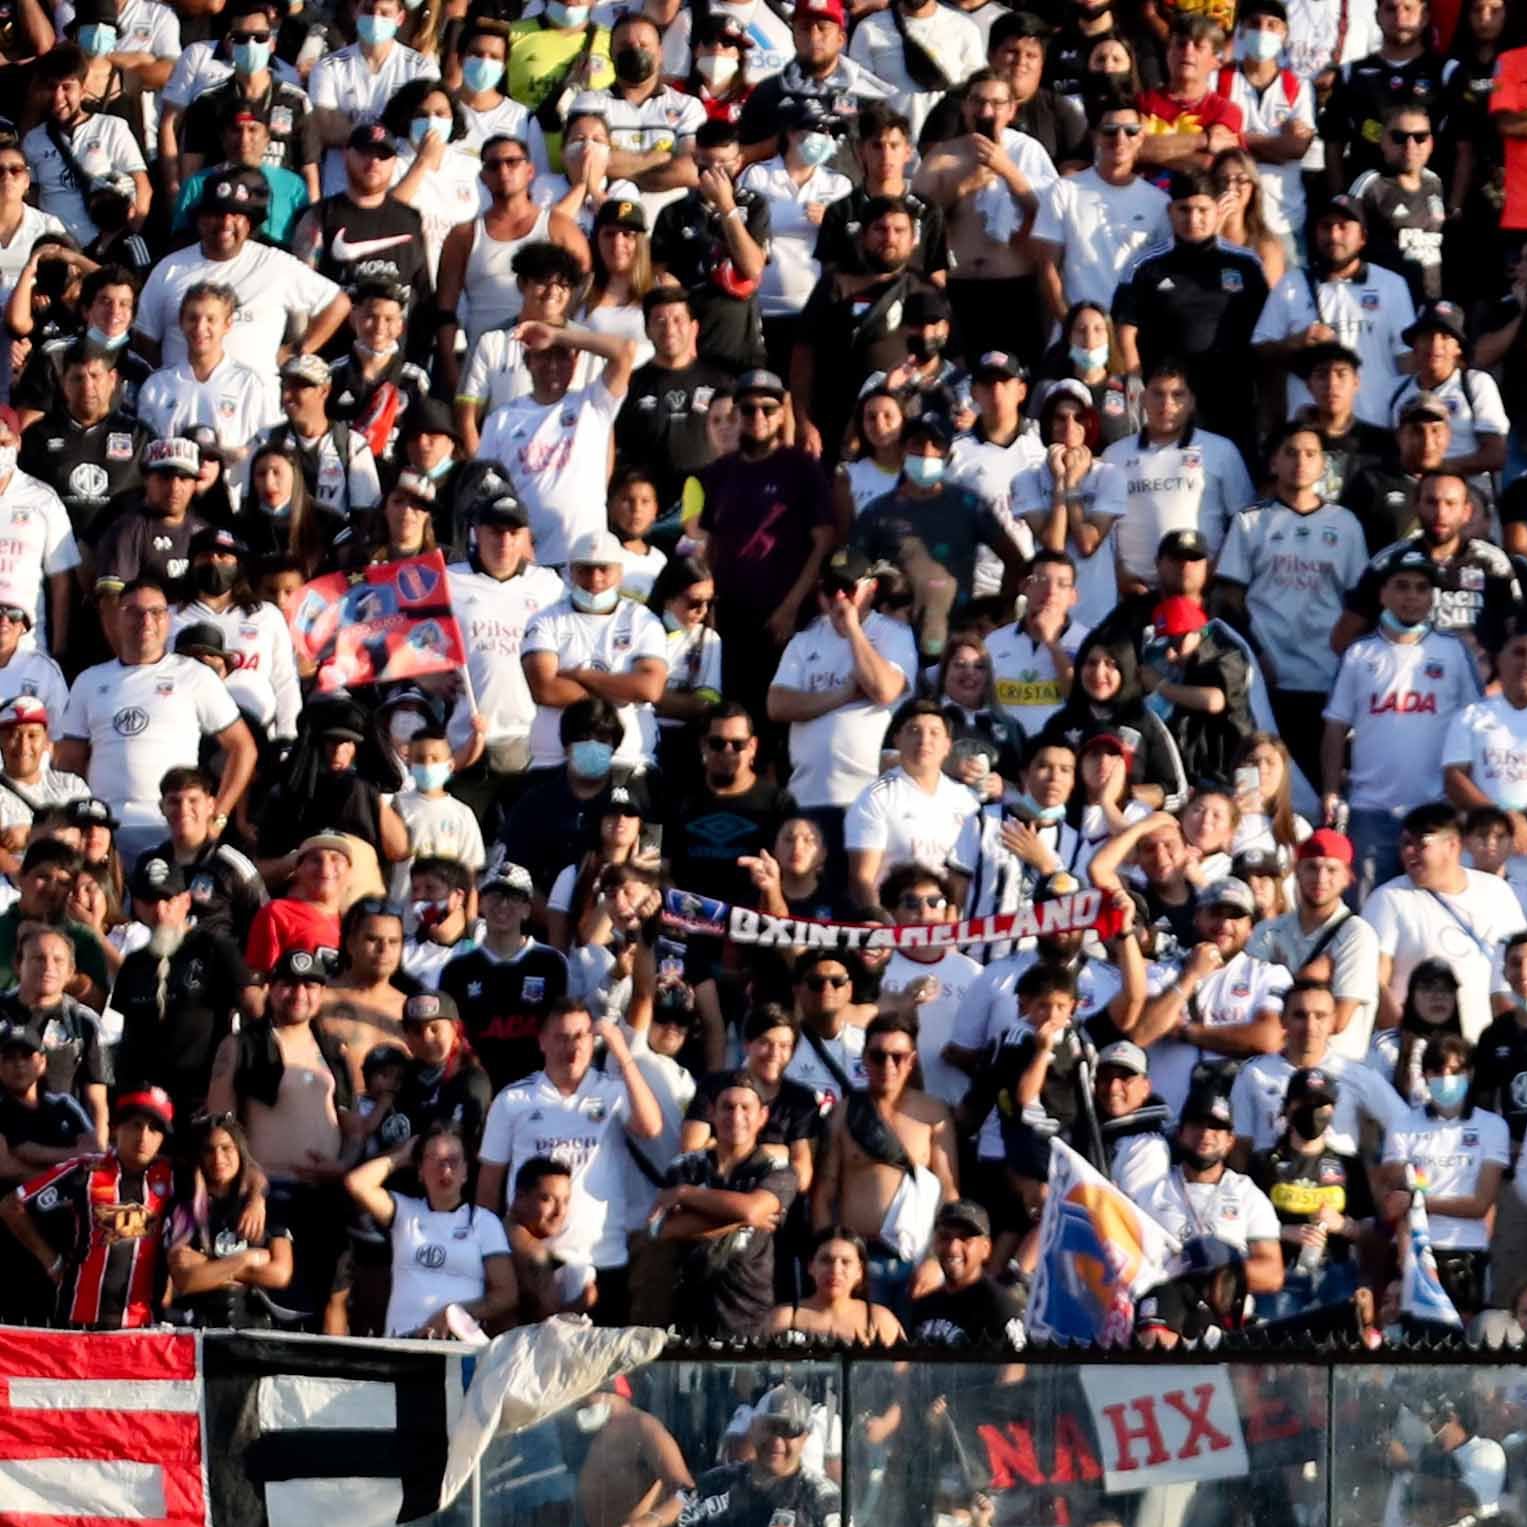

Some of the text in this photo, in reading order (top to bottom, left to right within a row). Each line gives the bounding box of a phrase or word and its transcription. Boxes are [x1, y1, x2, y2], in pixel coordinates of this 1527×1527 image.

[69, 462, 109, 495] MG
[1128, 477, 1195, 495] DIRECTV
[1370, 691, 1436, 715] LADA
[114, 706, 150, 735] MG
[416, 1244, 446, 1268] MG
[1103, 1383, 1234, 1471] HX
